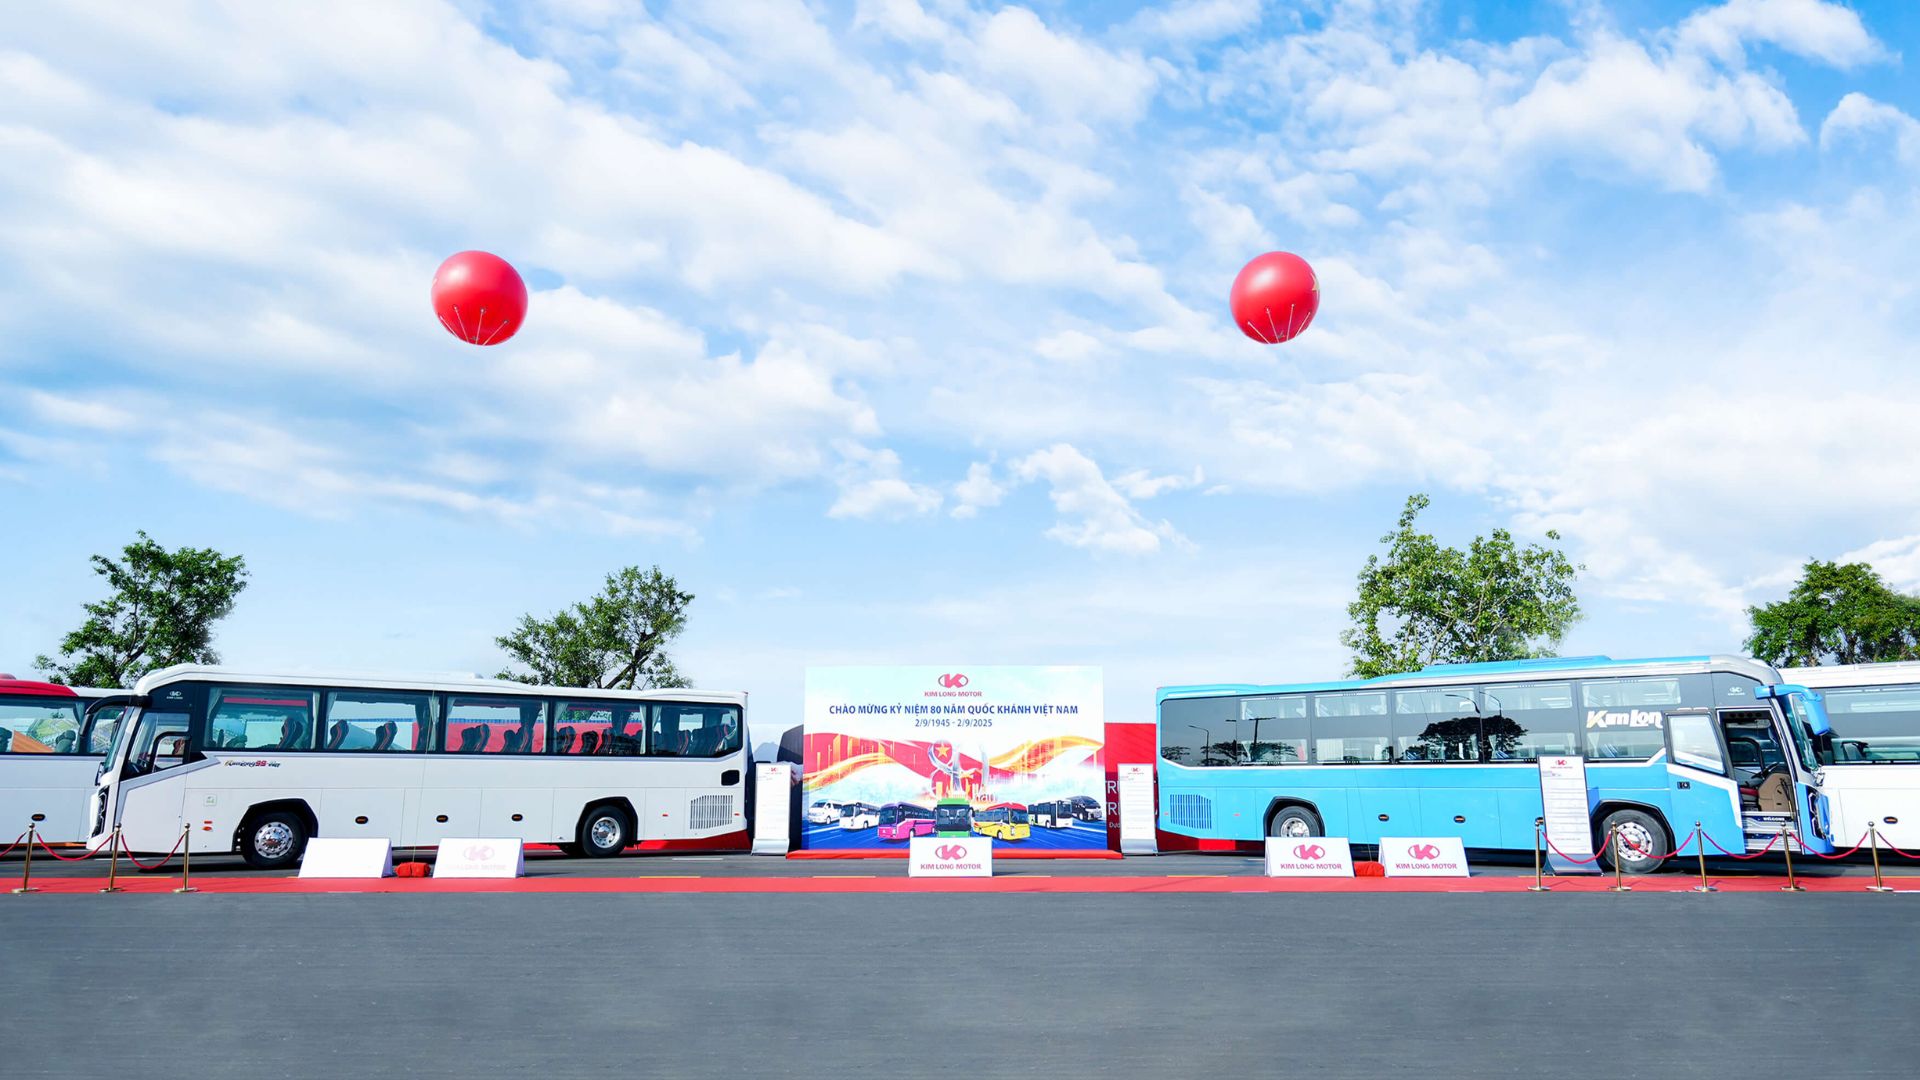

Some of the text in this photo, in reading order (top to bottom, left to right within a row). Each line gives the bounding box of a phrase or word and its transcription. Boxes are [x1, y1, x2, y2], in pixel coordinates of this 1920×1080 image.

[829, 702, 1078, 717] CHÀO MỪNG KỶ NIỆM 80 NĂM QUỐC KHÁNH VIỆT NAM
[914, 718, 951, 727] 2/9/1945
[957, 718, 993, 727] 2/9/2025
